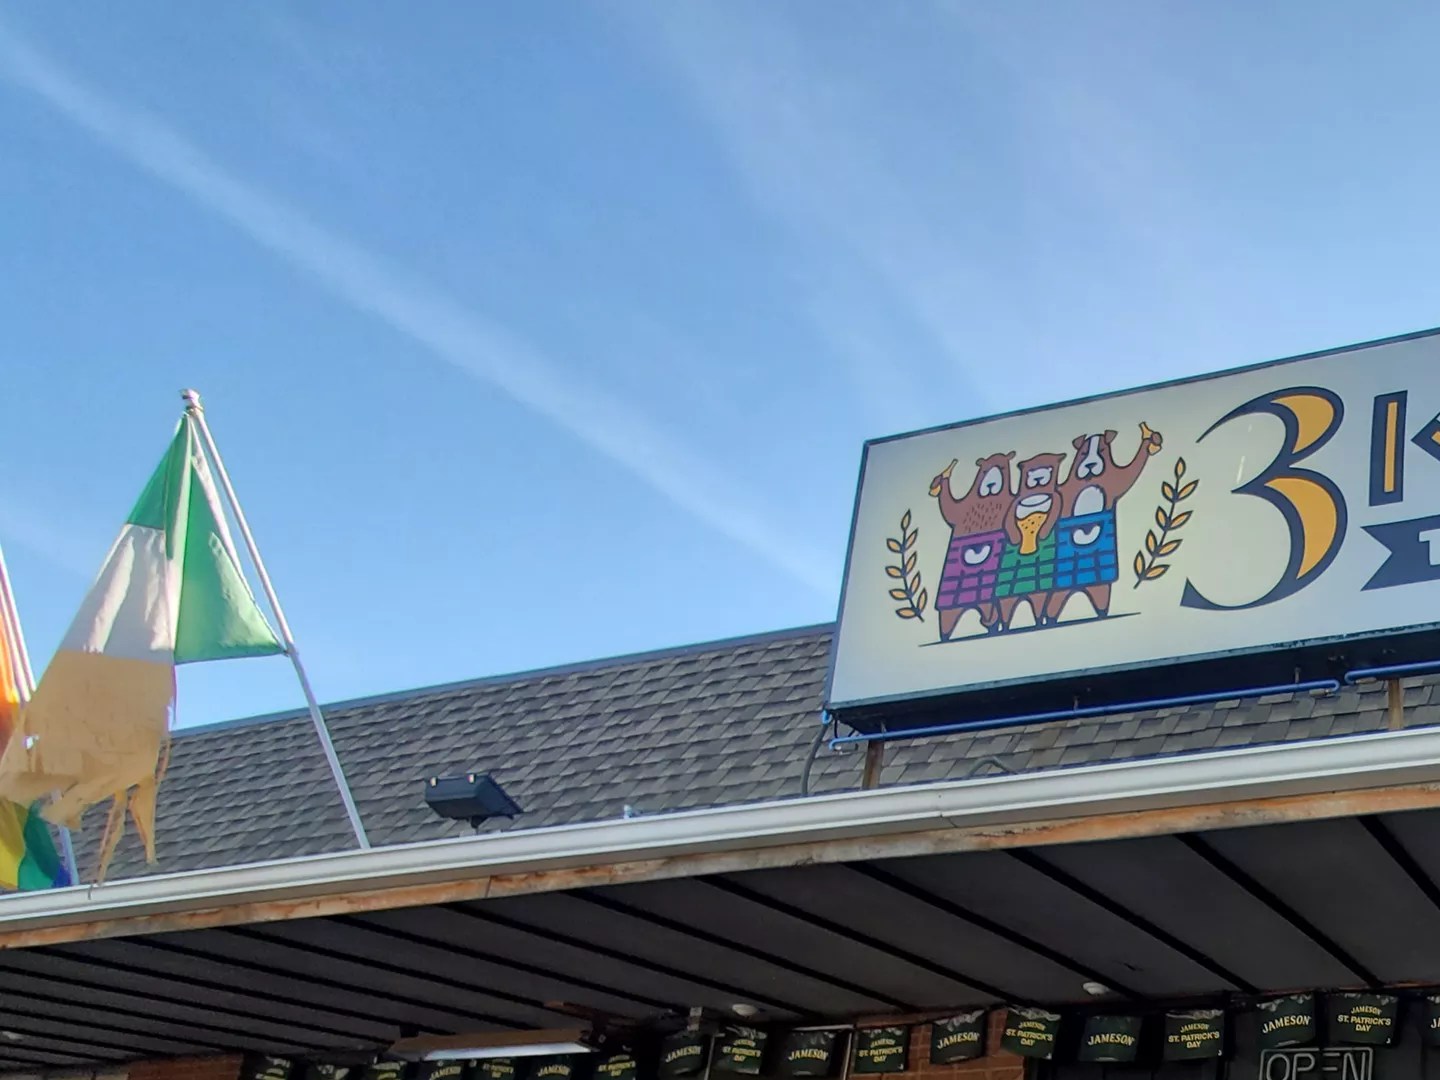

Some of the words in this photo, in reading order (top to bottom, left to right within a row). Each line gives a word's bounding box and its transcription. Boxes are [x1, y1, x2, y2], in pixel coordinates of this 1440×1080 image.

[1181, 385, 1349, 608] 3
[1350, 1005, 1382, 1015] JAMESON
[1262, 1015, 1311, 1034] JAMESON
[1337, 1014, 1349, 1023] ST.
[1350, 1015, 1392, 1026] PATRICK'S
[1019, 1022, 1045, 1031] JAMESON
[1180, 1023, 1210, 1033] JAMESON
[1355, 1023, 1372, 1032] DAY
[937, 1032, 980, 1049] JAMESON
[1020, 1038, 1035, 1046] DAY
[1087, 1033, 1135, 1047] JAMESON
[1168, 1034, 1180, 1043] ST.
[1181, 1031, 1220, 1042] PATRICK'S
[870, 1038, 896, 1048] JAMESON
[1186, 1041, 1201, 1049] DAY
[666, 1045, 703, 1063] JAMESON
[788, 1050, 829, 1061] JAMESON
[873, 1055, 887, 1063] DAY
[537, 1064, 570, 1077] JAMESON
